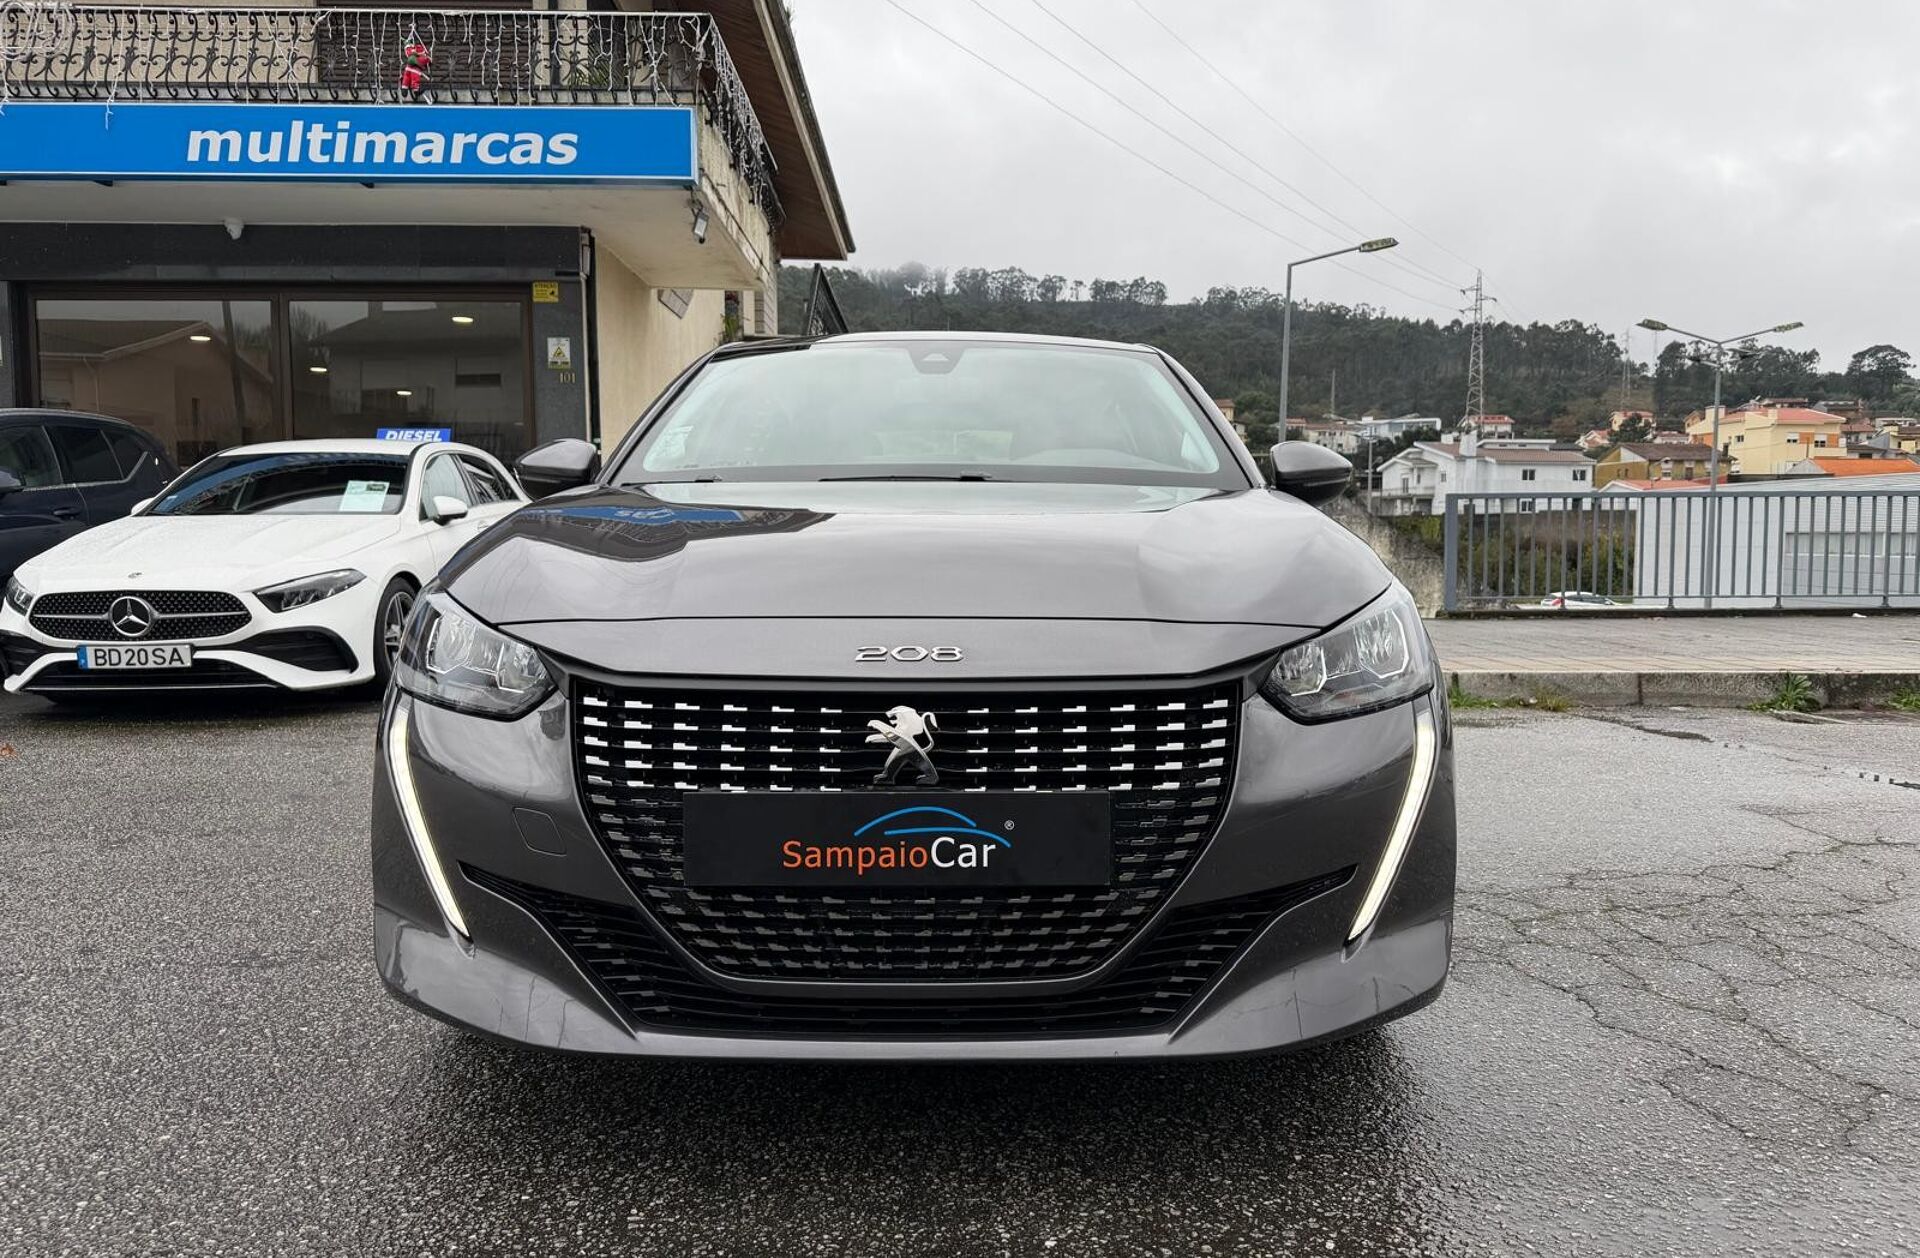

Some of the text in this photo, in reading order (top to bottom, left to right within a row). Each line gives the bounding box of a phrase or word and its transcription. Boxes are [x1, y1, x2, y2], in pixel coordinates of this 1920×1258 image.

[186, 120, 579, 165] multimarcas
[560, 372, 576, 385] 101
[385, 430, 442, 442] DIESEL
[855, 646, 964, 662] 208
[782, 836, 996, 875] SampaioCar
